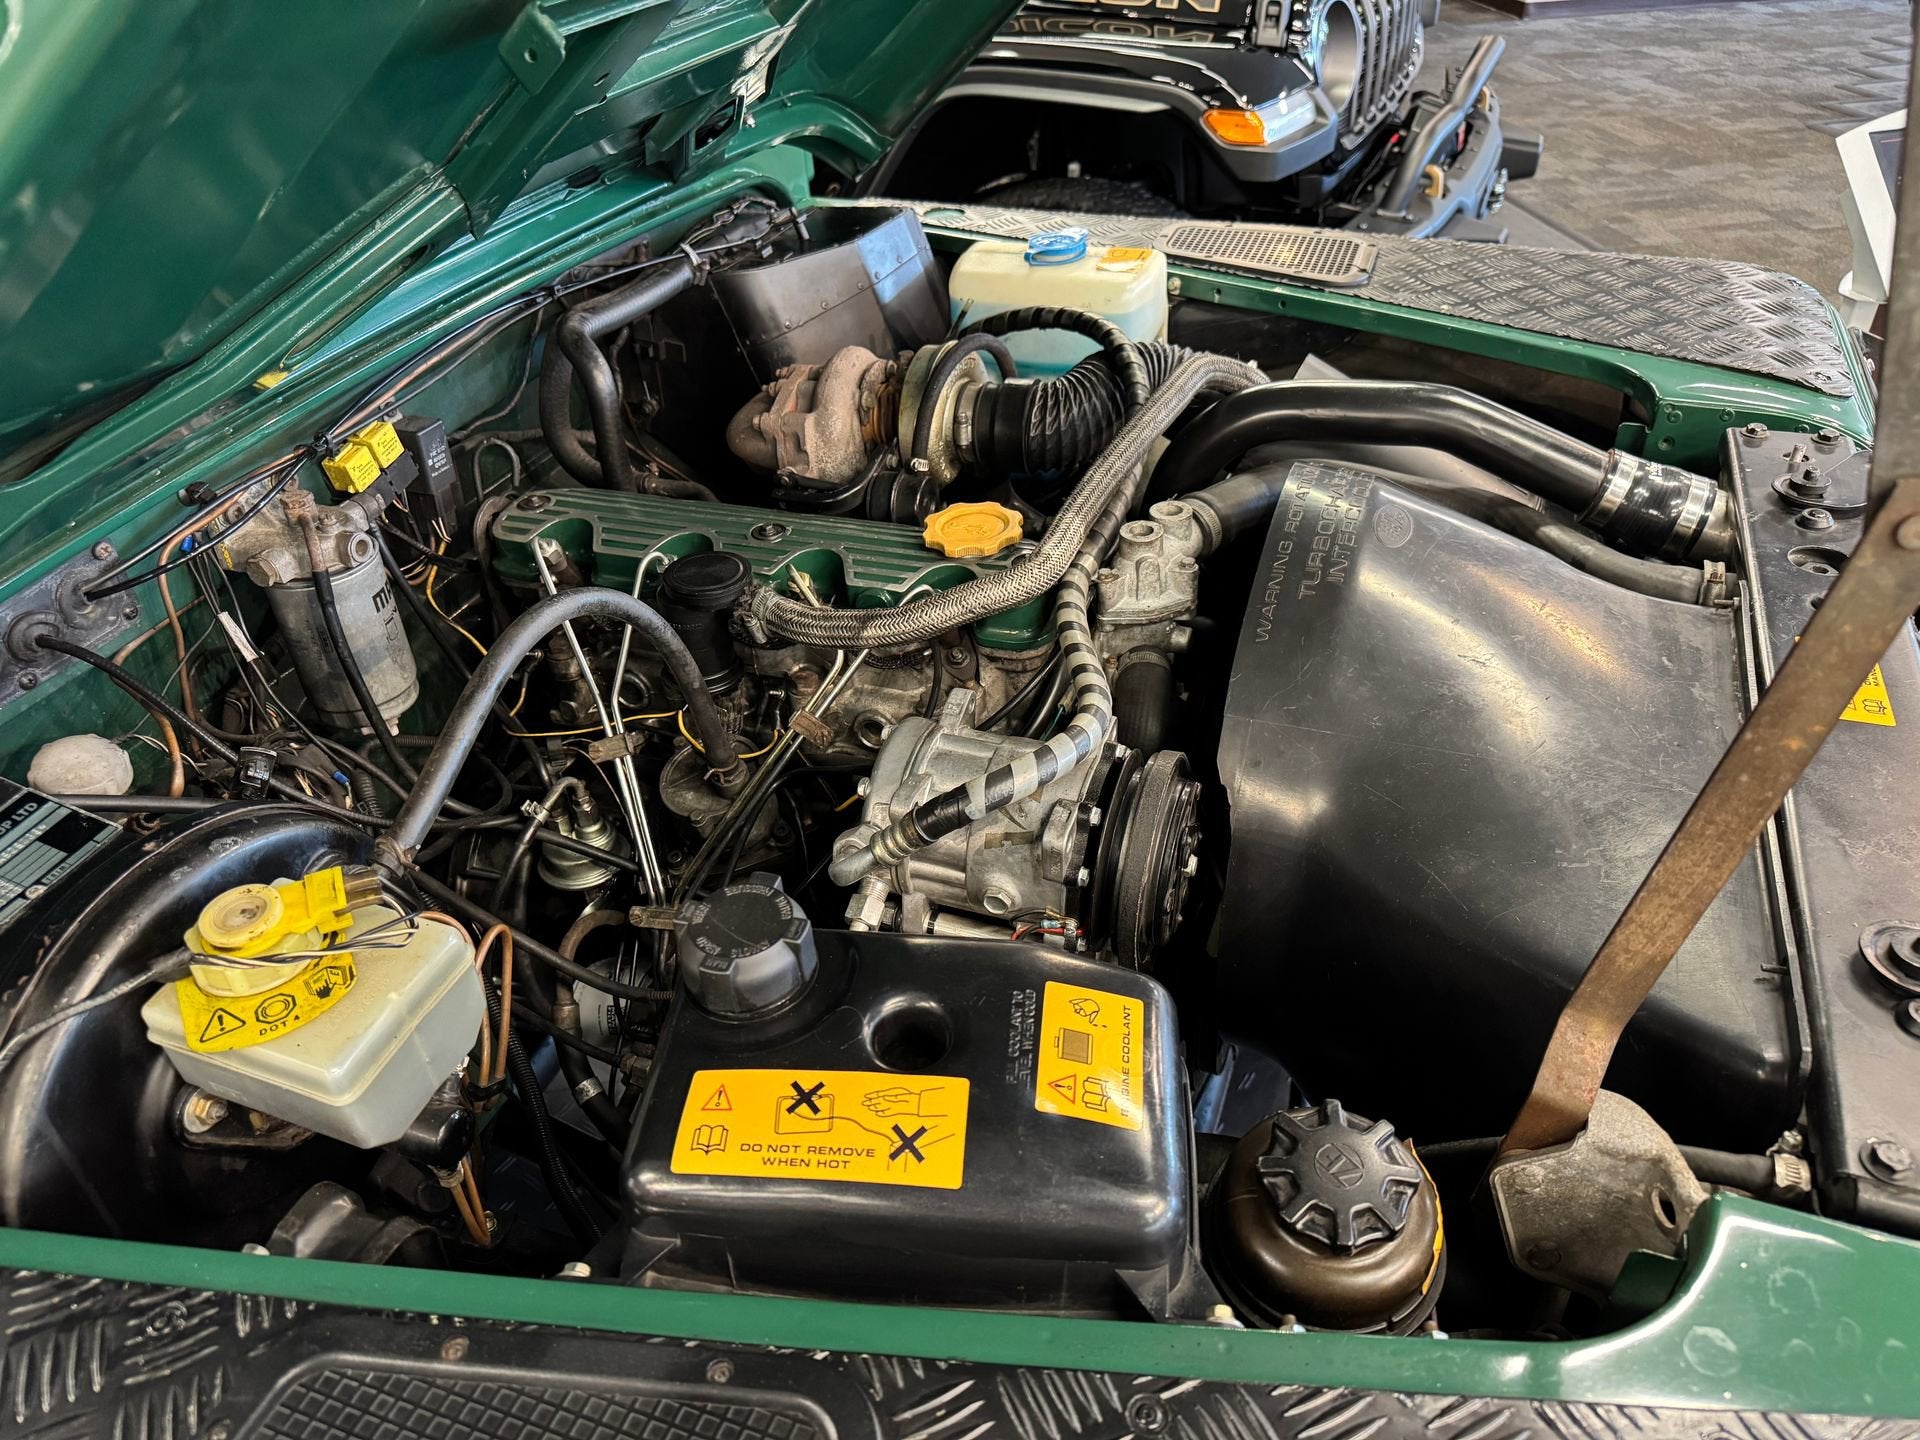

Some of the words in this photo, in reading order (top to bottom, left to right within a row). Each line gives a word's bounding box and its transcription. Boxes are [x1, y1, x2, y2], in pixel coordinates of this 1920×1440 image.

[1255, 540, 1293, 643] WARNING
[12, 802, 39, 821] LTD
[46, 864, 68, 884] TRIM
[1012, 990, 1024, 1005] TO
[1024, 988, 1037, 1016] COLD
[260, 1020, 287, 1036] DOT
[294, 1014, 301, 1022] 4
[1008, 1005, 1024, 1057] COOLANT
[1121, 1004, 1132, 1064] COOLANT
[1120, 1067, 1130, 1118] EGINE
[740, 1143, 763, 1153] DO
[767, 1144, 801, 1154] NOT
[807, 1145, 876, 1158] REMOVE
[761, 1156, 811, 1168] WHEN
[817, 1159, 851, 1170] HOT
